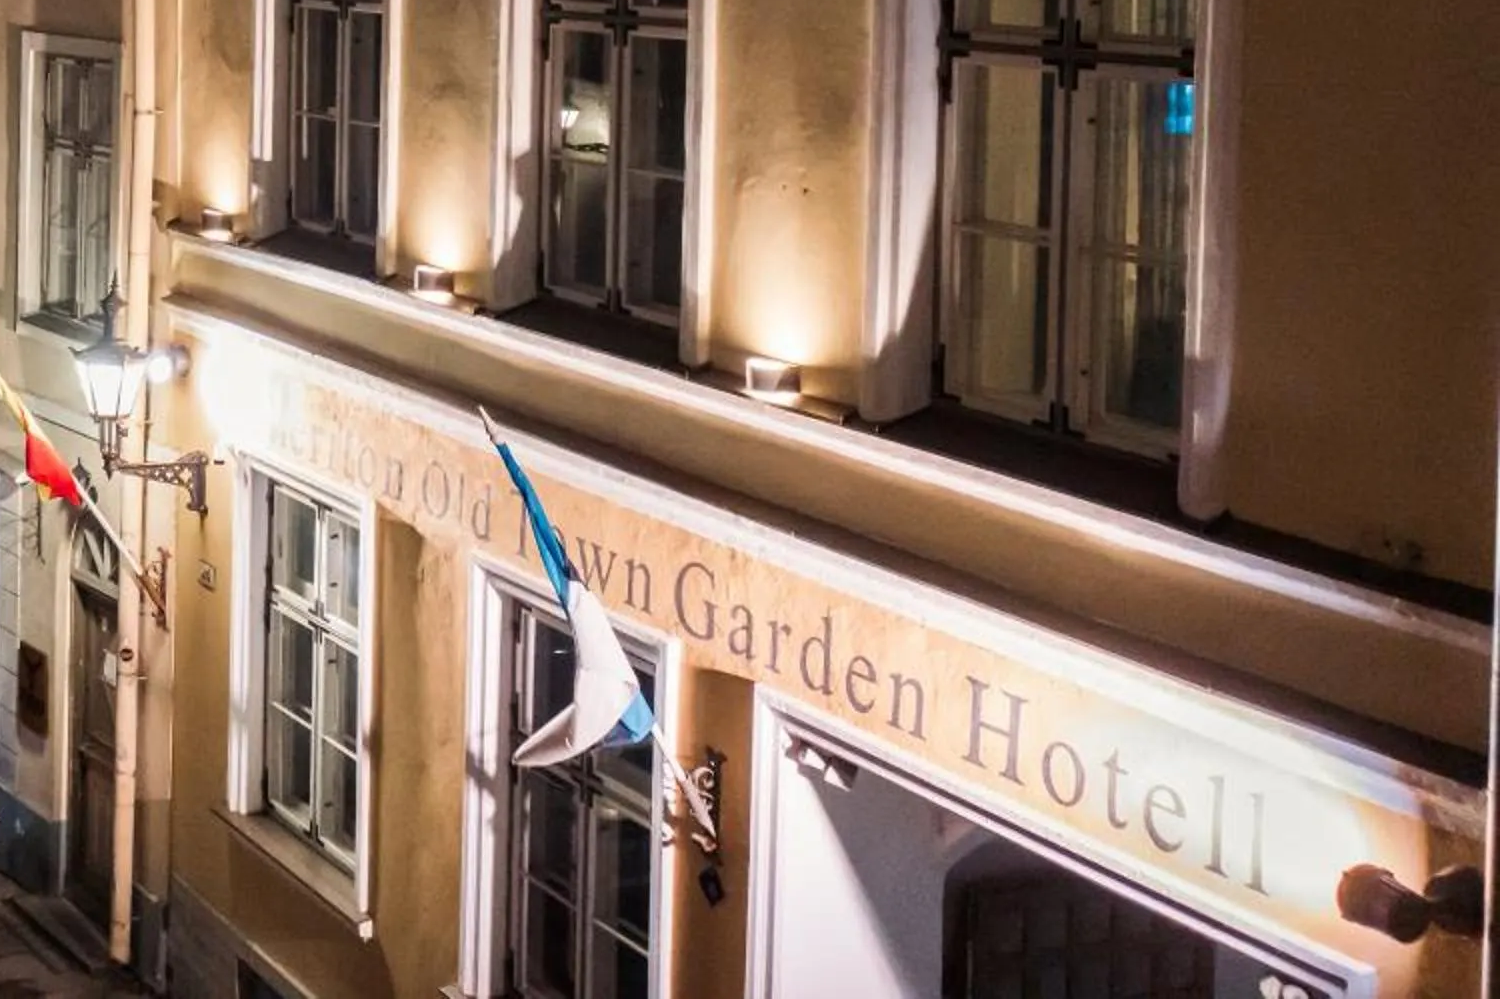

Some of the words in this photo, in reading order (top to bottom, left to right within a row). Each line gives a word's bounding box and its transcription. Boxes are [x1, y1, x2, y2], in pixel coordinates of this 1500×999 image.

[422, 458, 493, 541] Old
[510, 486, 653, 616] Twn
[674, 561, 927, 742] Garden
[962, 674, 1271, 897] Hotell
